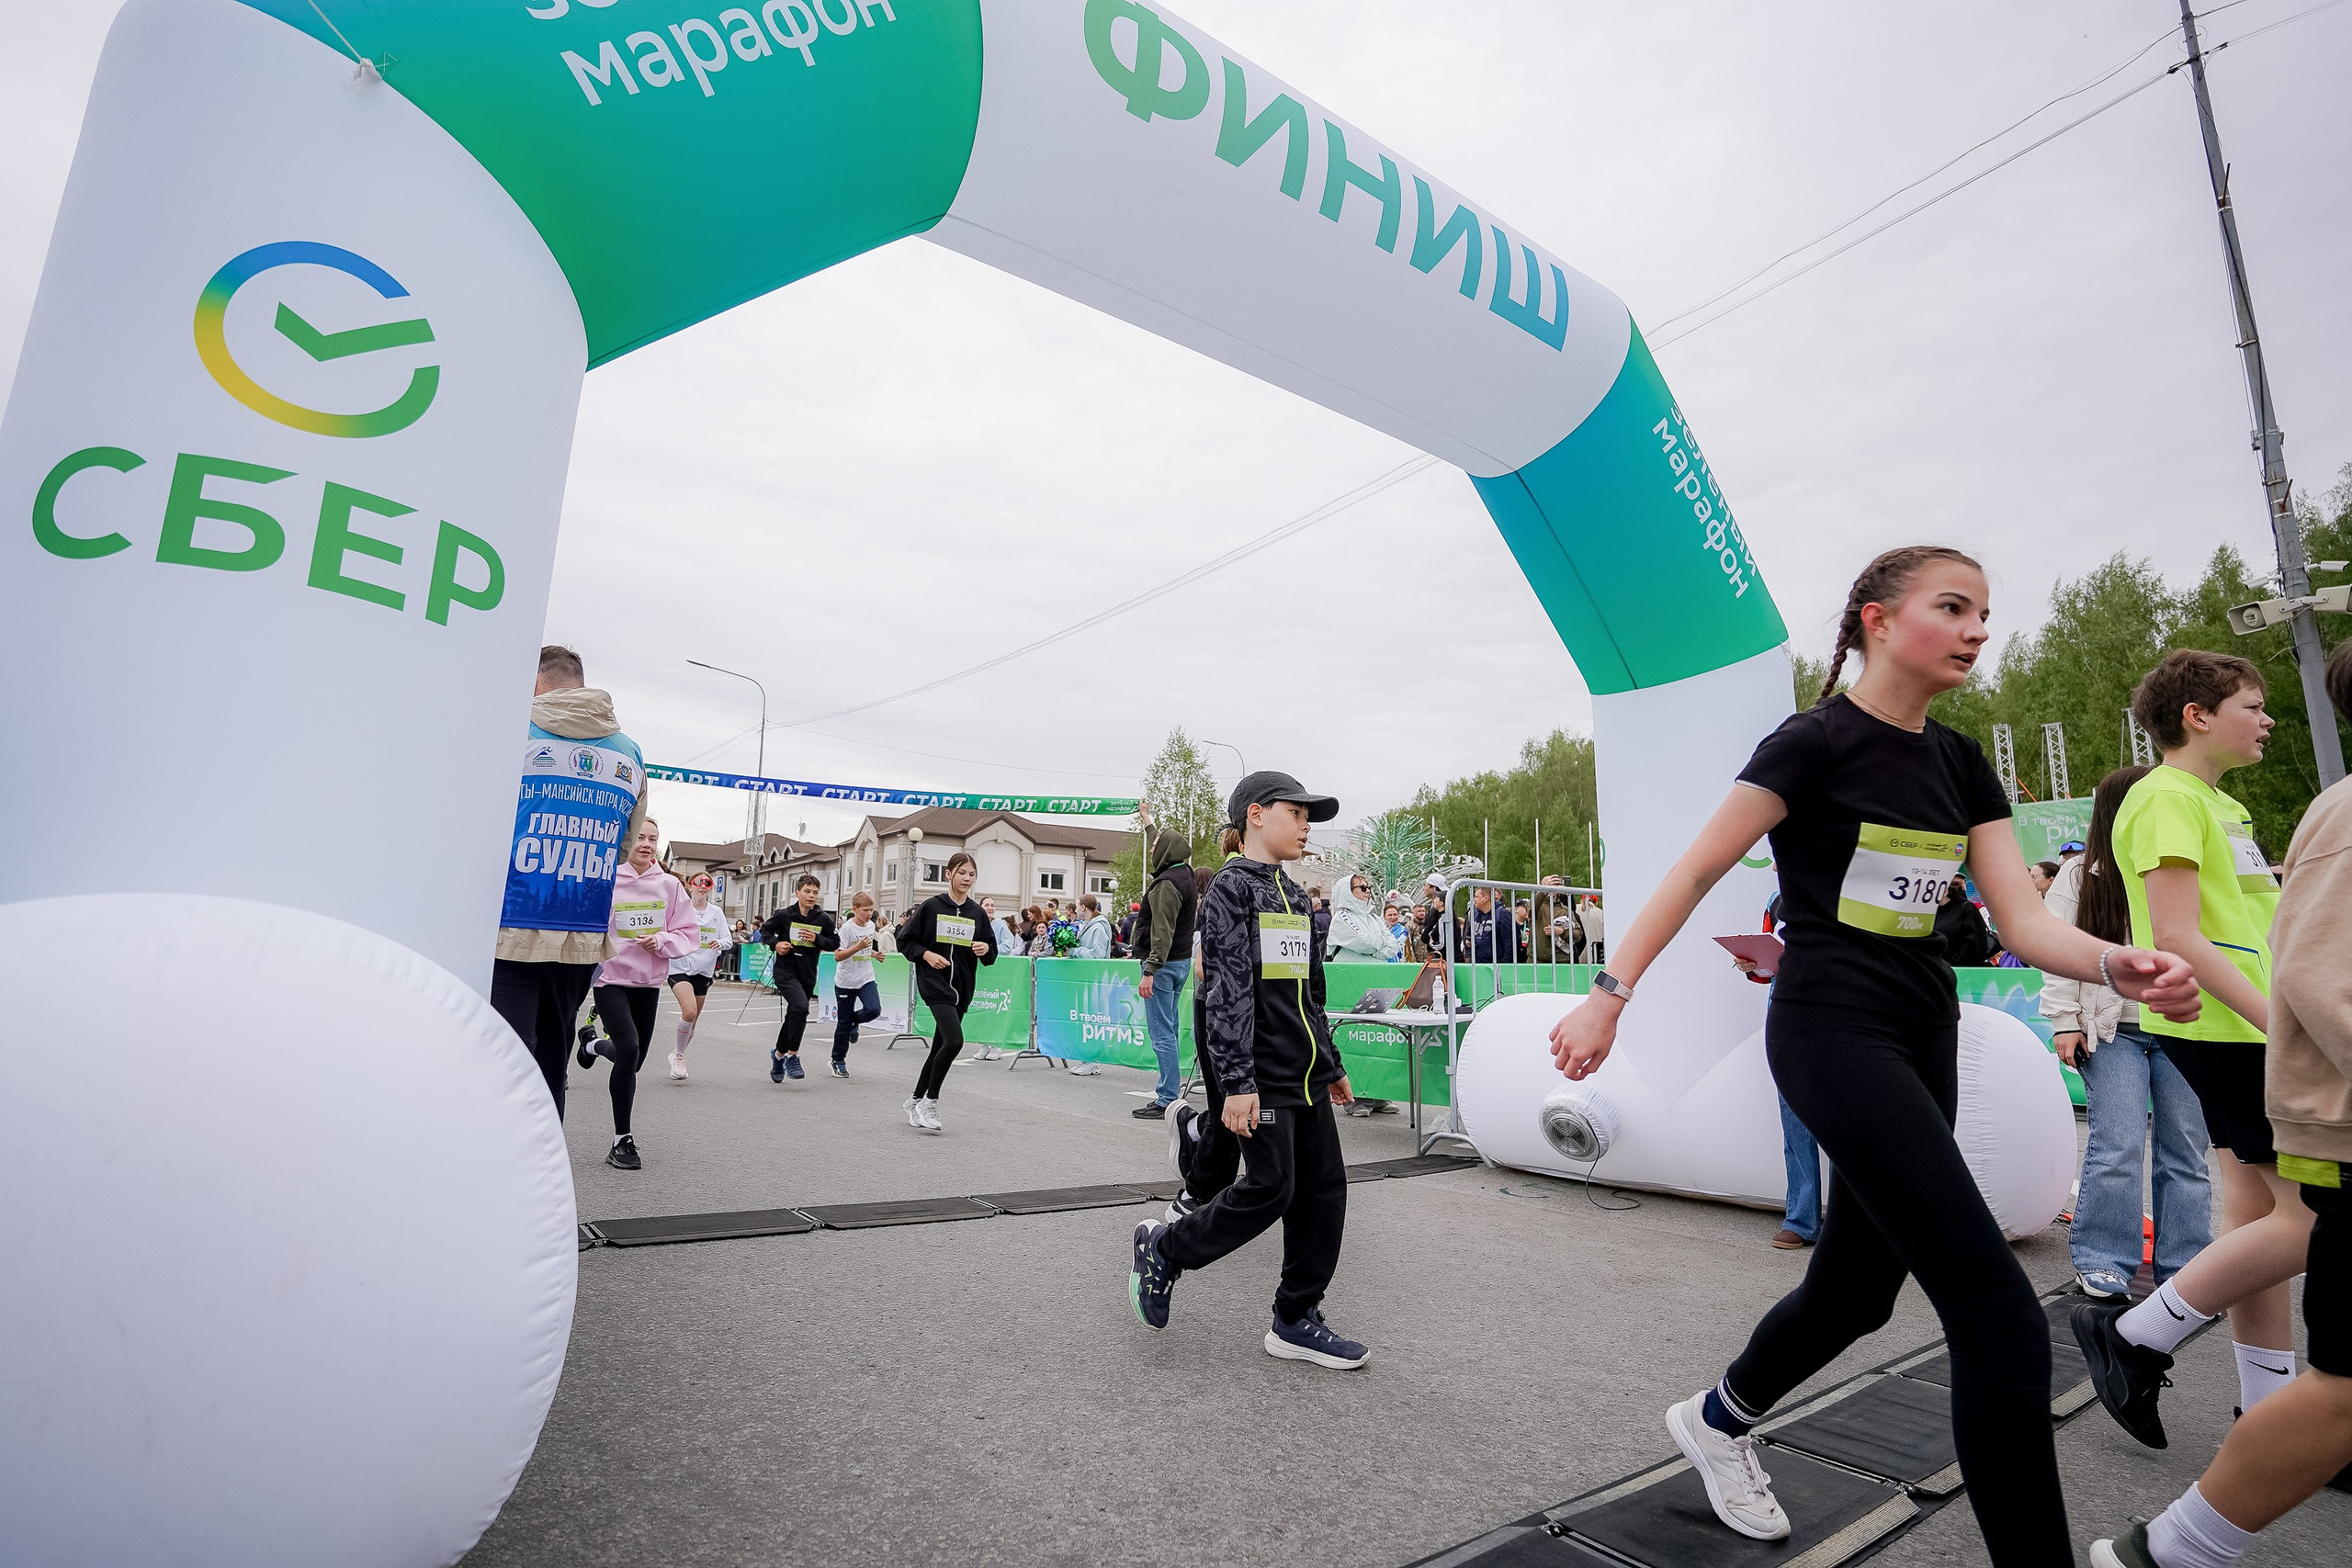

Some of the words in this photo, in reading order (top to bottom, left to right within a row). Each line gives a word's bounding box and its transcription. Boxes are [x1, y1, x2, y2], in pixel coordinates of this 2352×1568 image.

[560, 0, 897, 107] марафон
[1084, 0, 1570, 353] ФИНИШ
[1652, 417, 1749, 599] марафон
[32, 446, 505, 627] СБЕР
[595, 790, 617, 810] ЮГРА
[978, 798, 1037, 812] СТАРТ
[1046, 799, 1102, 813] СТАРТ
[527, 813, 620, 844] ГЛАВНЫЙ
[2018, 816, 2027, 826] В
[2032, 814, 2076, 826] твоём
[514, 837, 617, 883] СУДЬЯ
[1889, 876, 1948, 905] 3180
[629, 916, 654, 927] 3136
[946, 926, 966, 936] 3154
[1280, 941, 1307, 957] 3179
[1069, 1010, 1078, 1021] В
[1079, 1012, 1111, 1024] твоём
[1082, 1023, 1145, 1046] ритме
